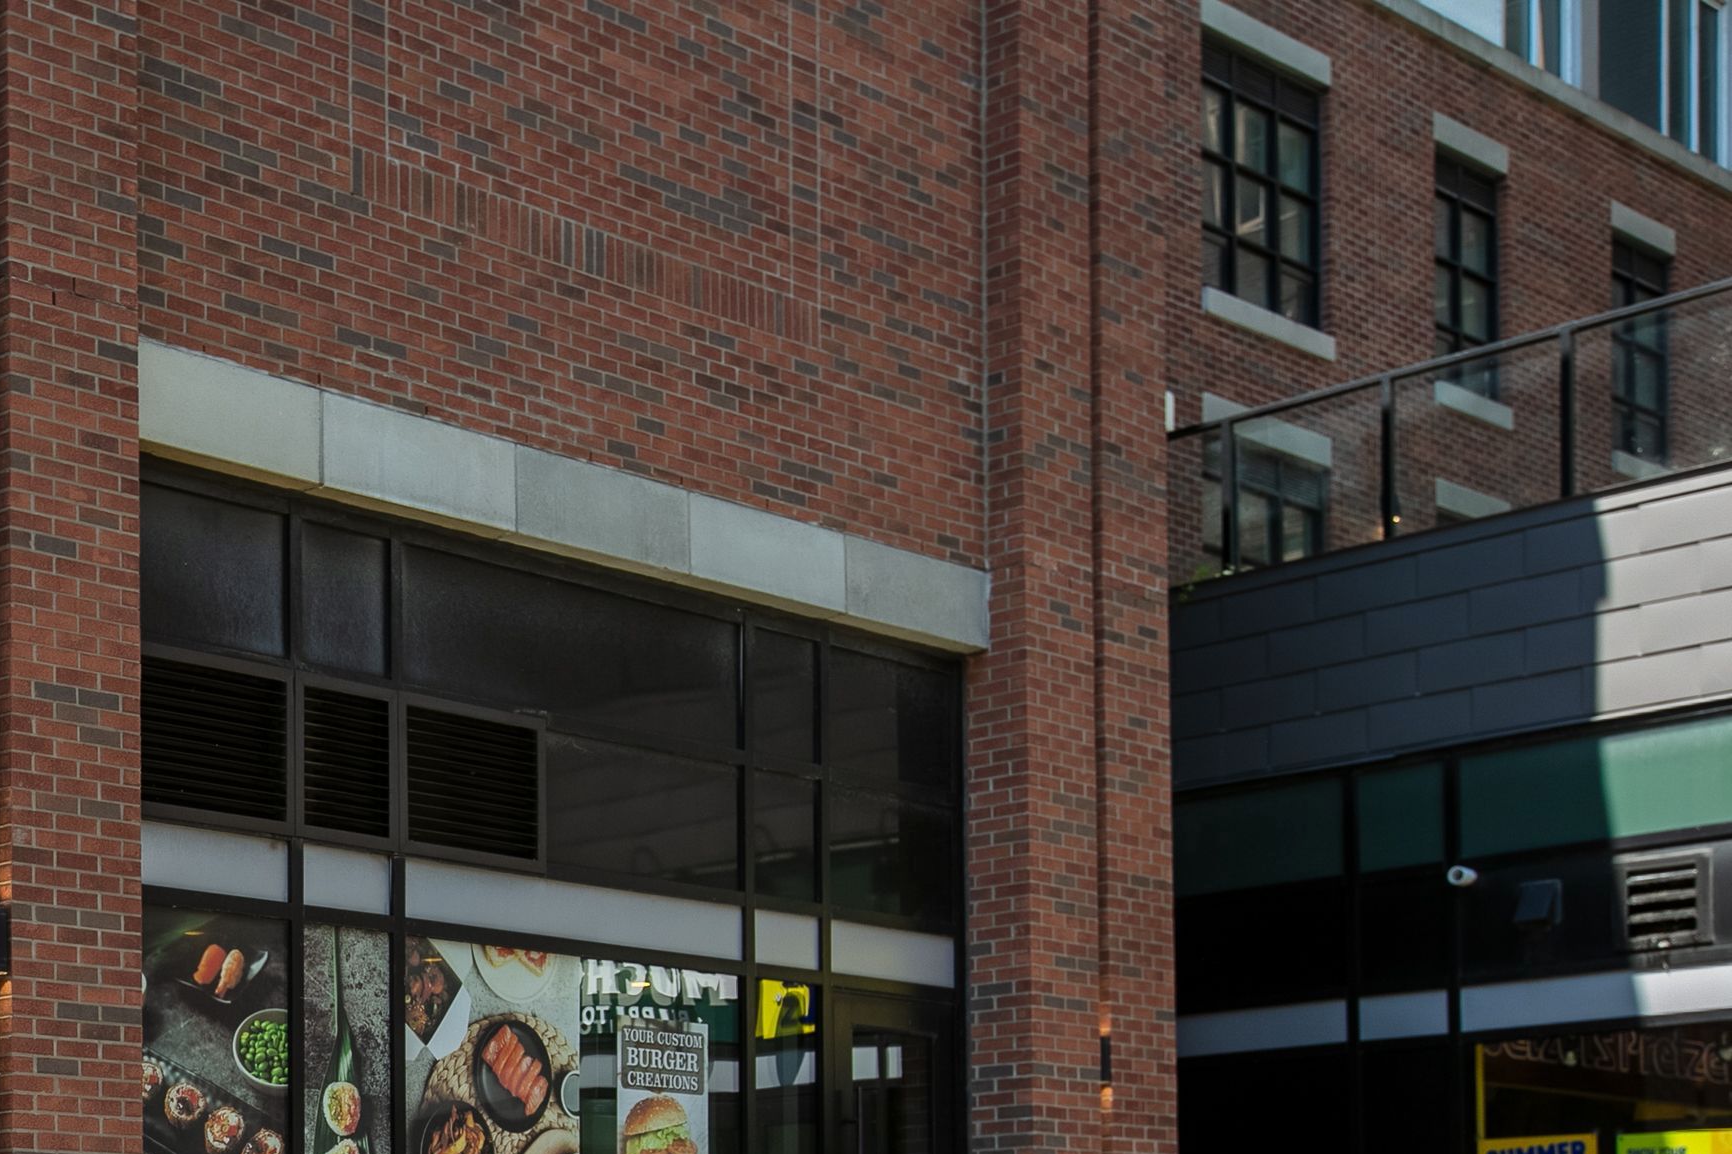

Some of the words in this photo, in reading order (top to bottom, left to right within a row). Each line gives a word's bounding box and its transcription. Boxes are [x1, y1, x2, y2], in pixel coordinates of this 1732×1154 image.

[623, 1028, 654, 1044] YOUR
[657, 1031, 703, 1049] CUSTOM
[626, 1047, 699, 1072] BURGER
[628, 1070, 698, 1091] CREATIONS
